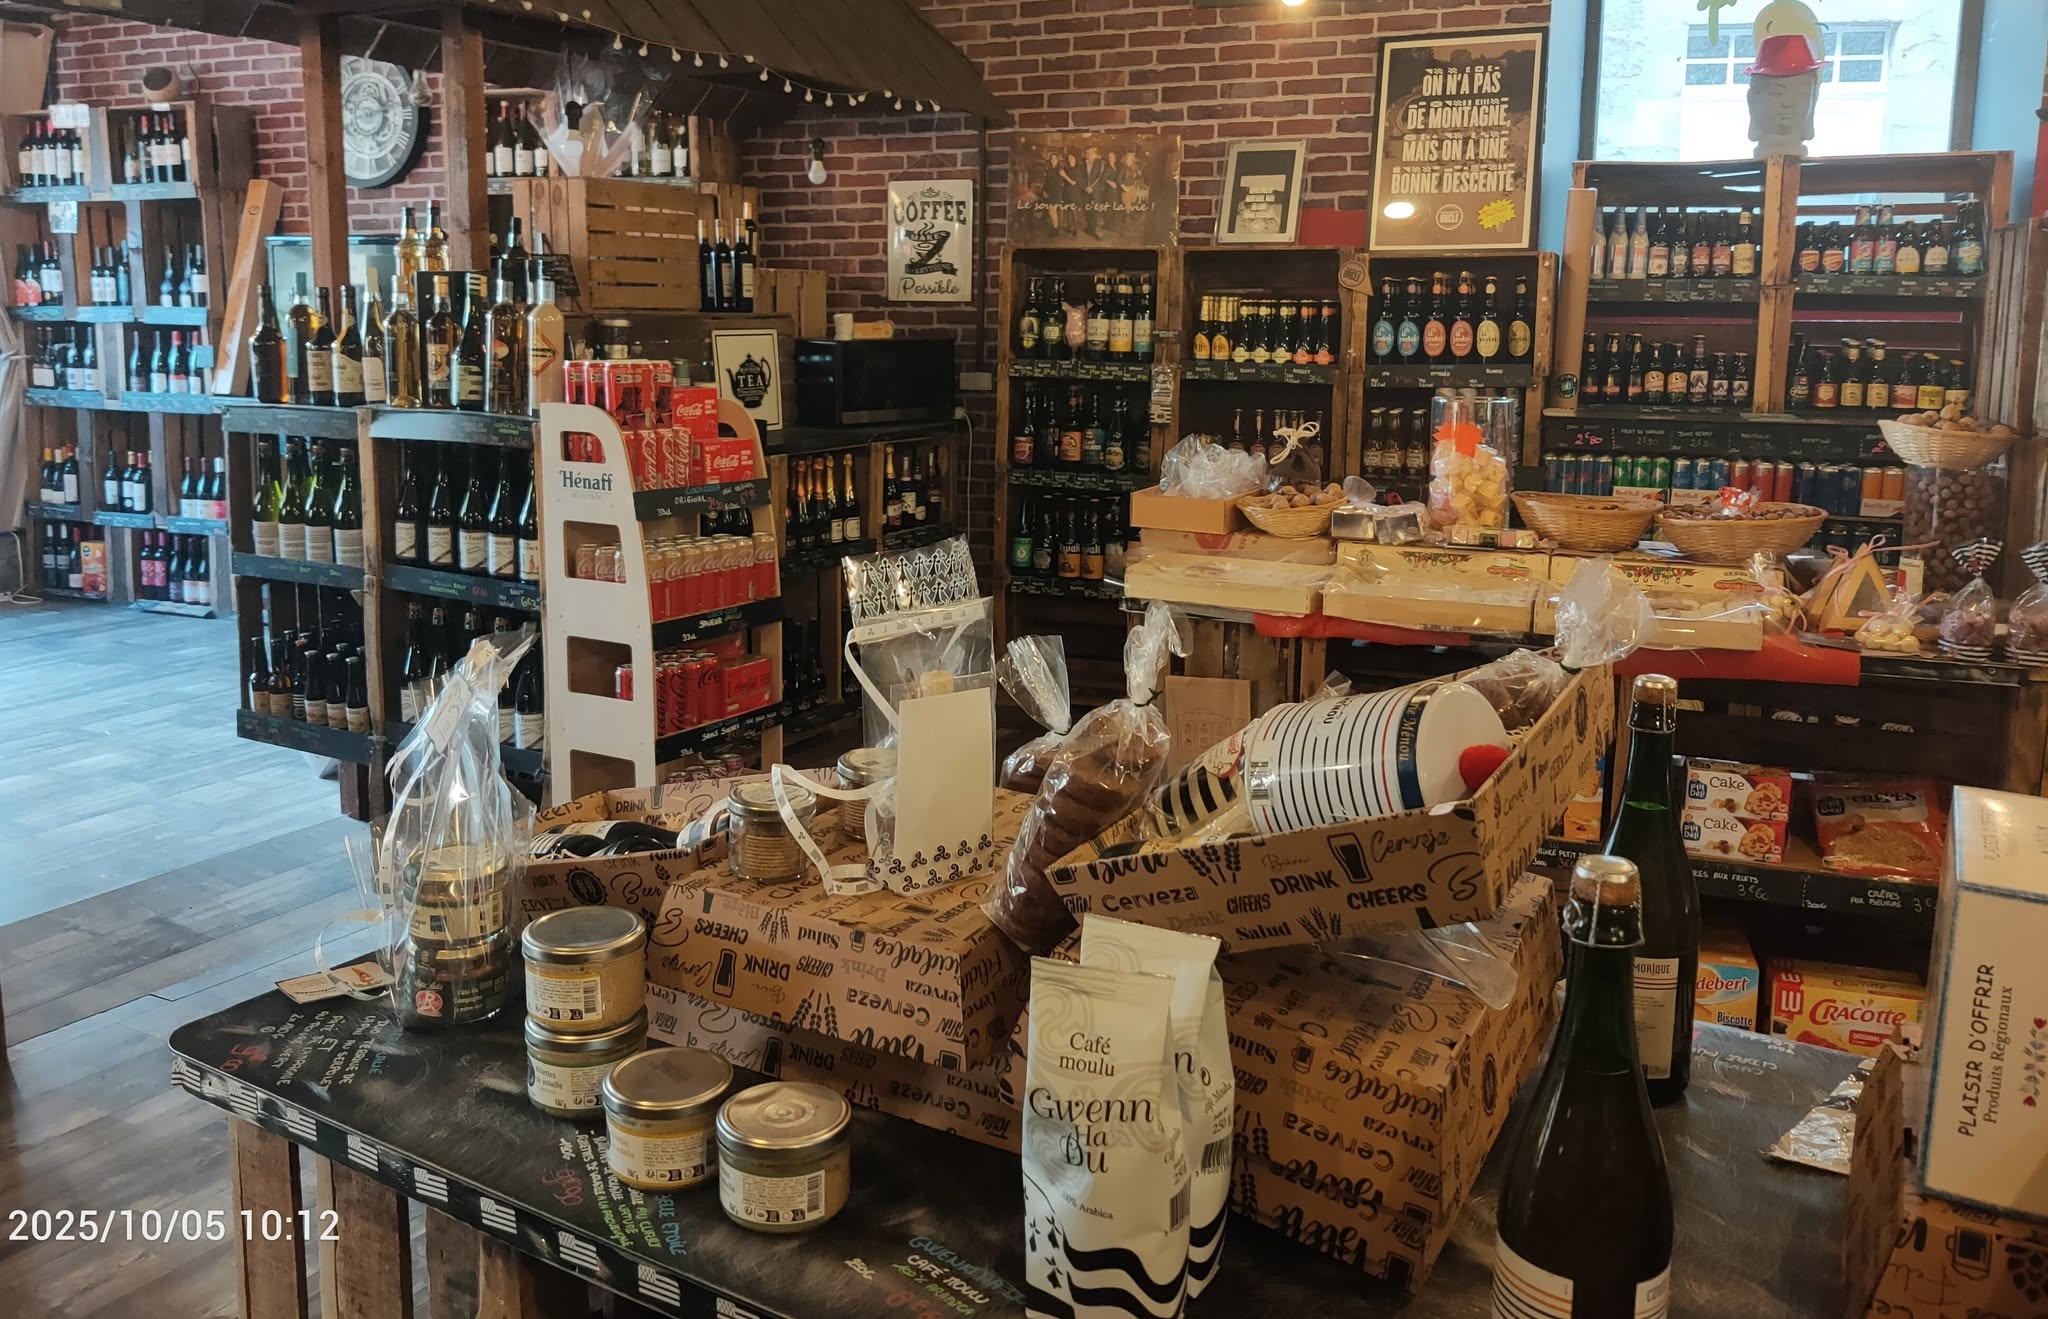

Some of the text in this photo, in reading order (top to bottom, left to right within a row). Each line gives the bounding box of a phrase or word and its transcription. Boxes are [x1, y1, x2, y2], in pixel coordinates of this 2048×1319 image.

[1422, 67, 1501, 96] ON N'A PAS
[1407, 101, 1511, 130] DE MONTAGNE,
[1402, 132, 1507, 162] MAIS ON A UNE
[1391, 164, 1515, 194] BONNE DESCENTE
[893, 199, 966, 225] COFFEE
[1017, 199, 1030, 210] Le
[1034, 199, 1081, 213] sourire,
[1084, 200, 1110, 212] c'est
[1113, 201, 1126, 211] la
[900, 276, 960, 296] Possible
[737, 375, 763, 388] TEA
[676, 403, 704, 417] Coca-Cola
[713, 454, 740, 468] Coca-Cola
[560, 469, 613, 492] Hénaff
[1399, 716, 1416, 761] Ménou
[1709, 776, 1745, 791] Cake
[615, 798, 646, 814] DRINK
[1703, 817, 1739, 833] Cake
[610, 871, 663, 905] Beer
[1270, 869, 1340, 896] DRINK
[1713, 870, 1759, 884] AUX FRUITS
[1101, 885, 1199, 912] Cerveza
[1227, 893, 1272, 914] CHEERS
[1346, 882, 1428, 910] CHEERS
[694, 917, 749, 946] CHEERS
[797, 926, 840, 950] Salud
[1236, 921, 1292, 942] Salud
[743, 953, 790, 982] DRINK
[795, 955, 834, 978] CHEERS
[846, 987, 931, 1028] Cerveza
[1780, 990, 1801, 1012] LU
[1717, 1010, 1753, 1027] Biscotte
[1070, 1032, 1112, 1055] Café
[1957, 963, 1995, 1137] PLAISIR D'OFFRIR
[1983, 985, 2014, 1125] Produits Régionaux
[789, 1041, 835, 1072] DRINK
[1058, 1055, 1115, 1077] moulu
[887, 1081, 971, 1119] Cerveza
[1029, 1087, 1154, 1123] Gwenn
[1281, 1111, 1394, 1172] Cerveza
[636, 1206, 648, 1219] AU
[1079, 1203, 1114, 1221] Arabica
[907, 1254, 990, 1305] CAFÉ MOULU
